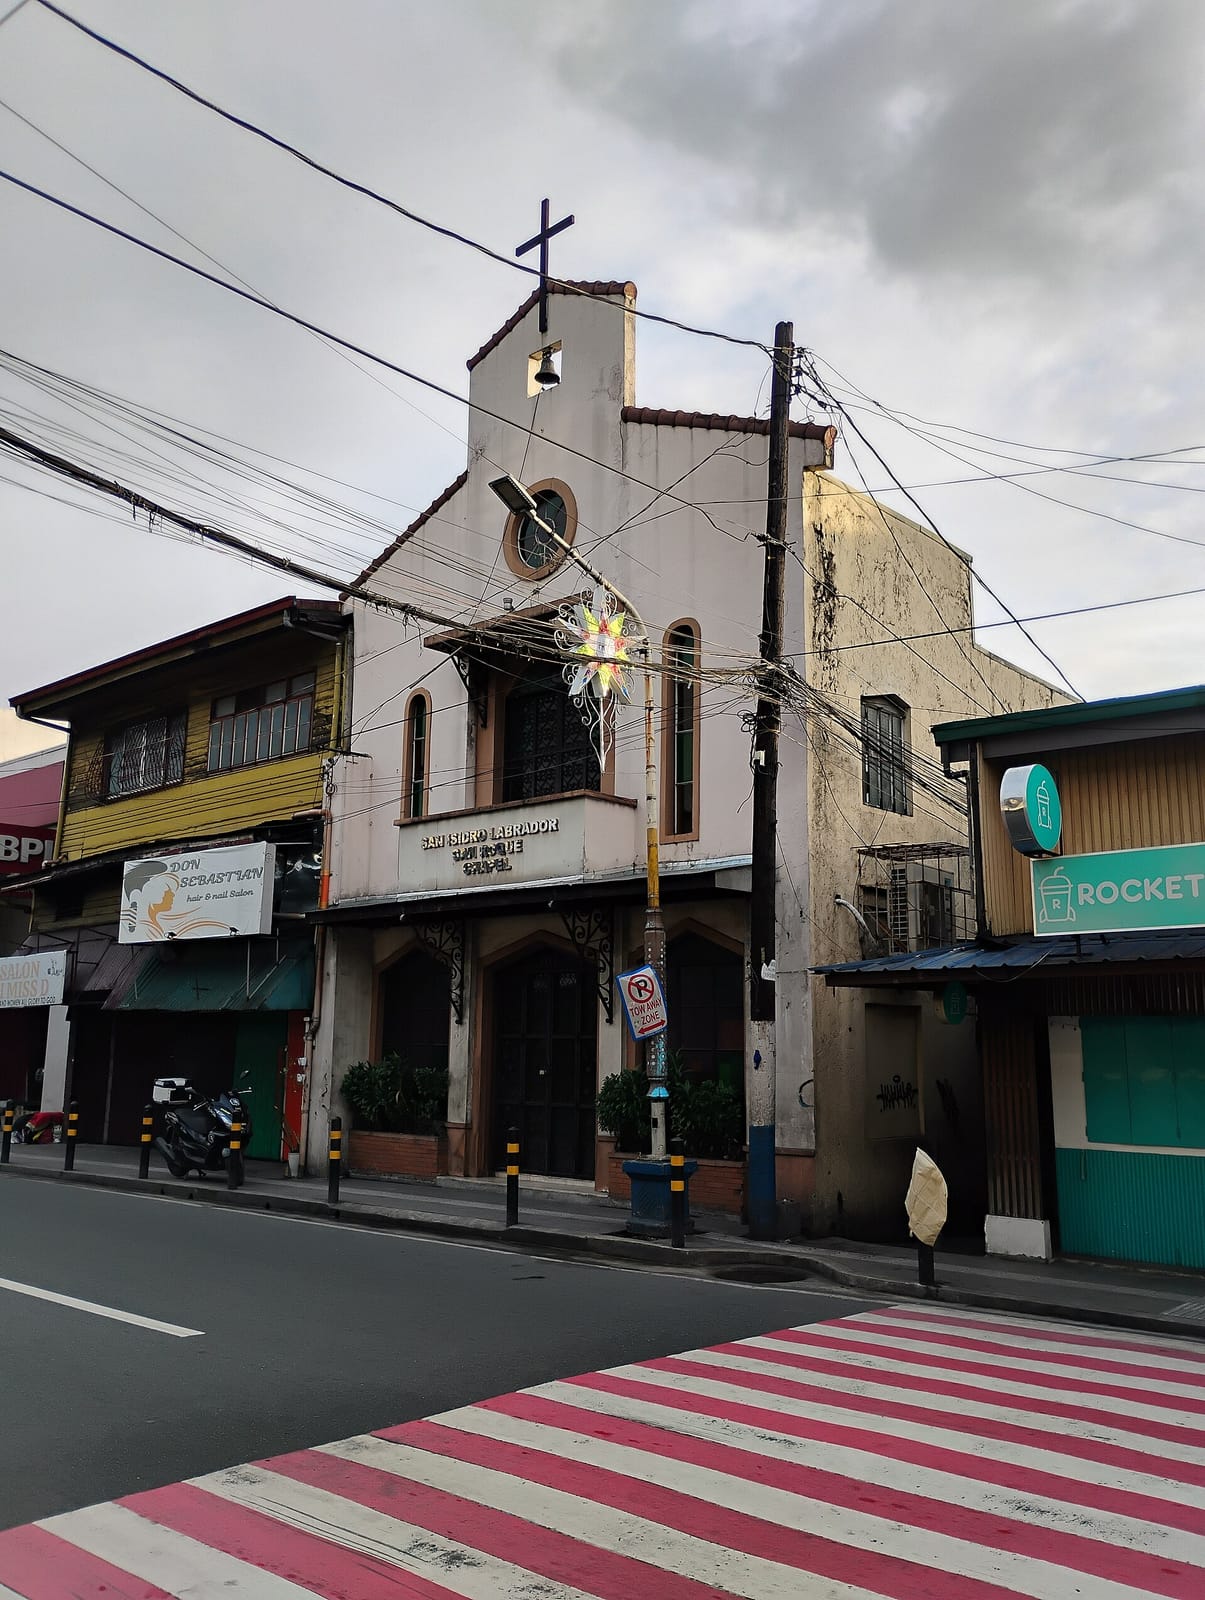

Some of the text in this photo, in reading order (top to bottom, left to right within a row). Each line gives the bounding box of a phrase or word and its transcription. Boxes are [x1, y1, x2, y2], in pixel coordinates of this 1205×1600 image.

[421, 818, 559, 850] SAN ISIDRO LABRADOR
[0, 834, 54, 863] BPI
[480, 839, 524, 858] ROQUE
[169, 858, 201, 873] DON
[462, 857, 513, 875] CHAPEL
[180, 866, 263, 888] SEBASTIAN
[186, 888, 254, 903] hair & nail Salon
[1077, 873, 1205, 906] ROCKET
[1052, 898, 1061, 910] R
[0, 960, 40, 979] SALON
[7, 980, 38, 999] MISS
[40, 979, 49, 997] D
[629, 996, 663, 1017] TOW AWAY
[641, 1010, 660, 1025] ZONE
